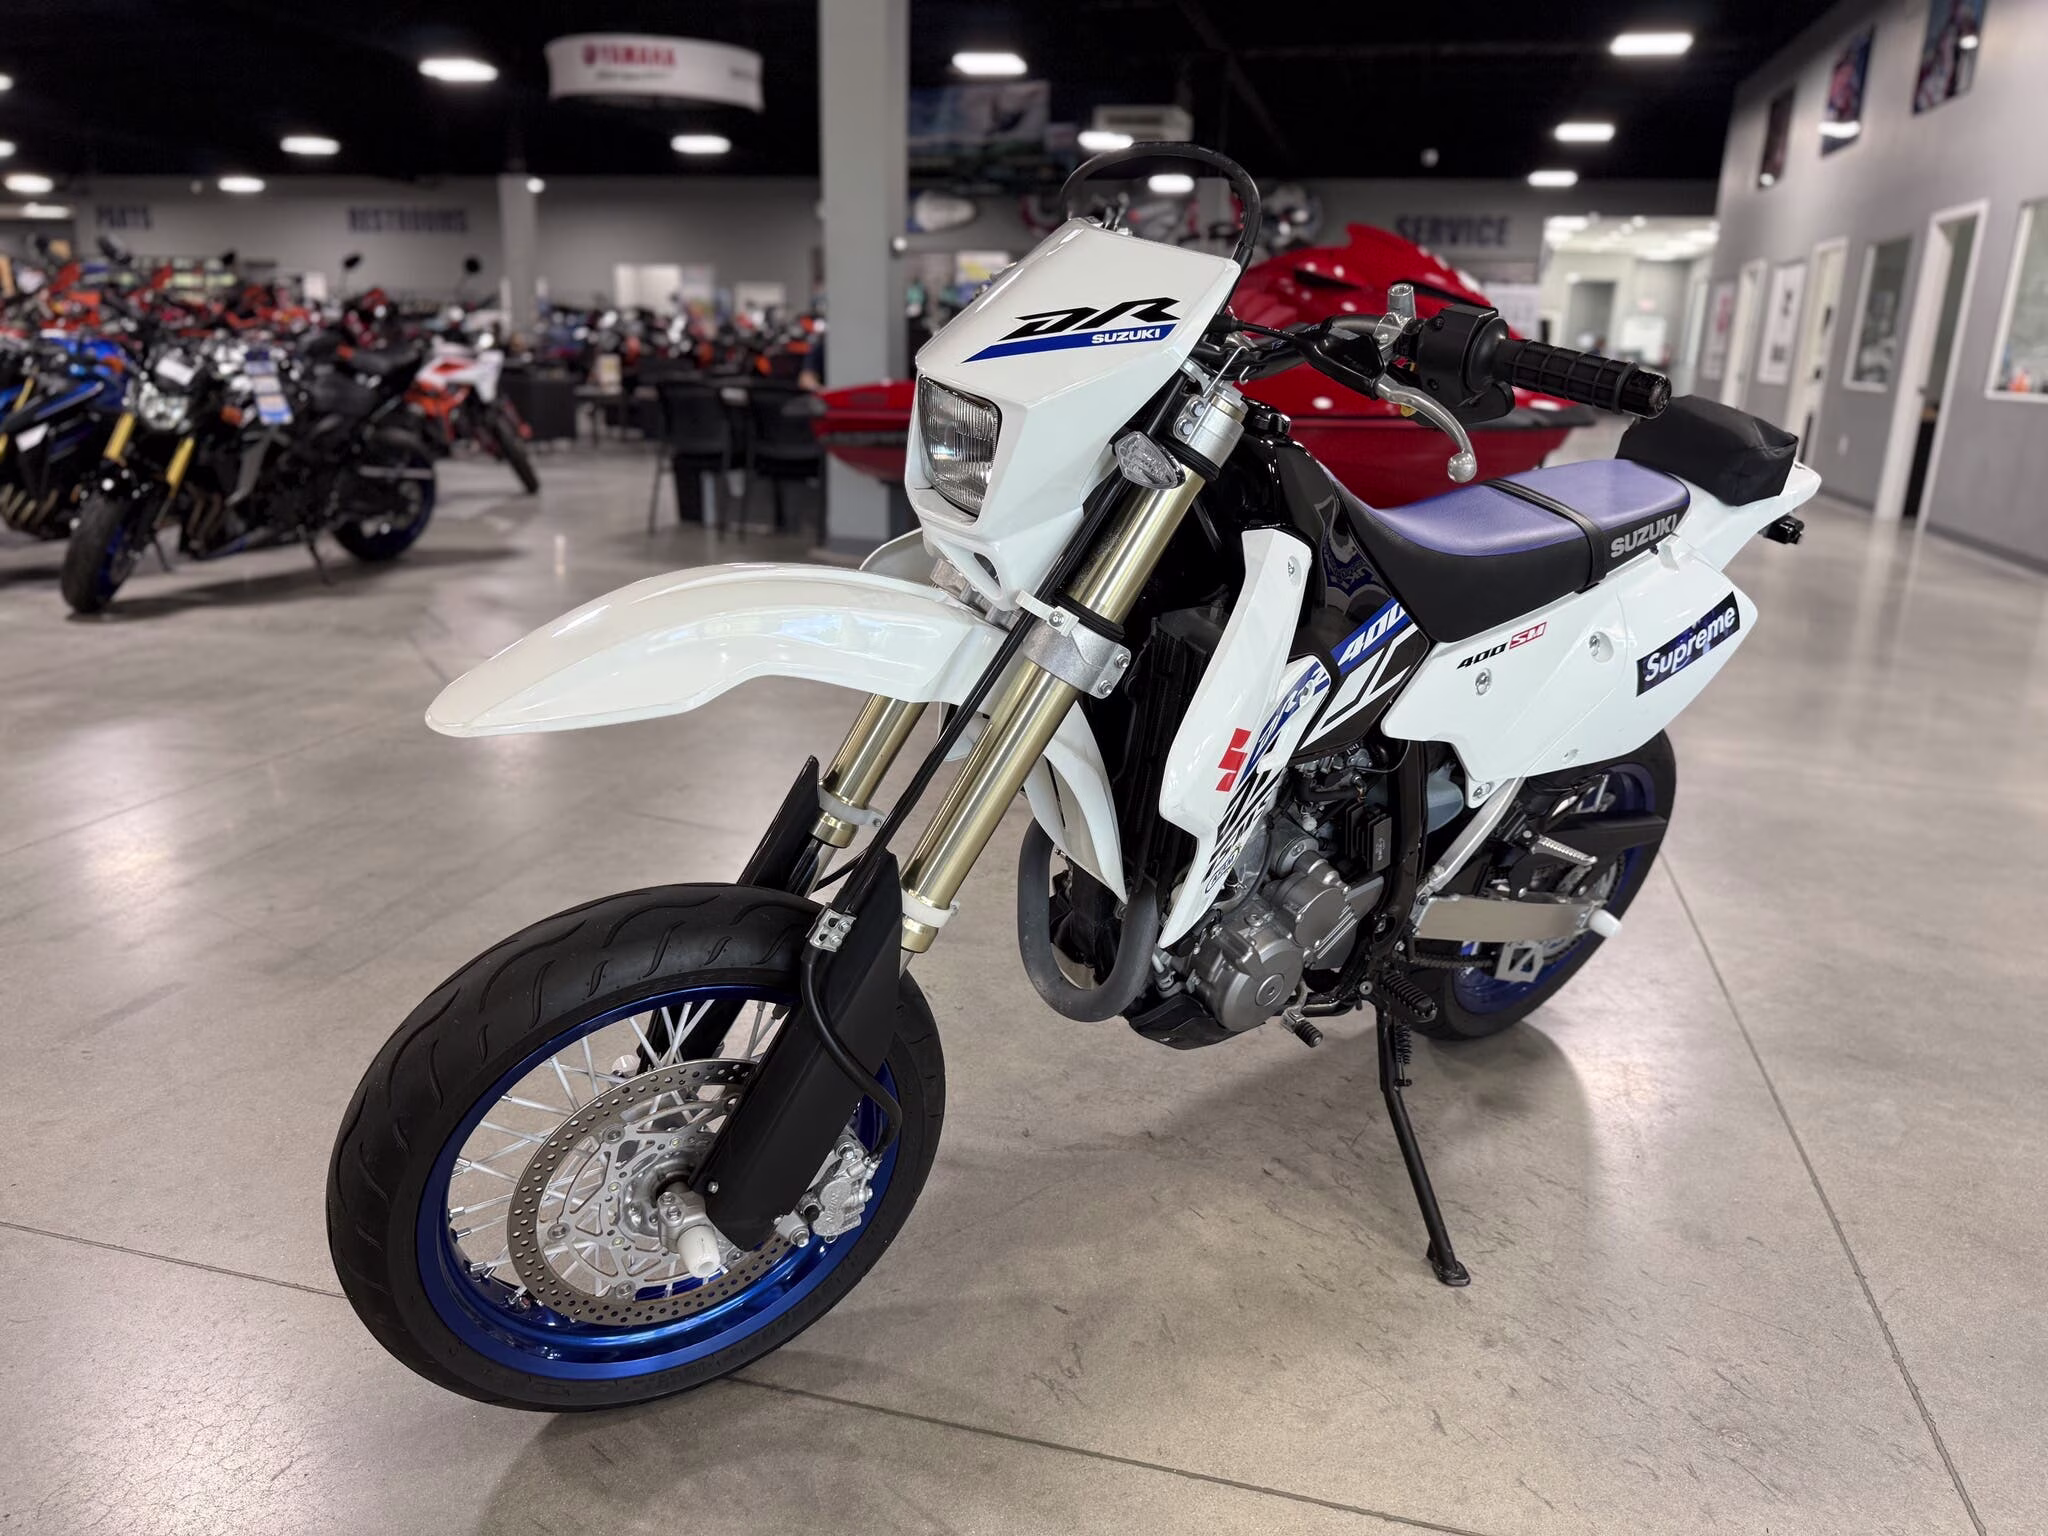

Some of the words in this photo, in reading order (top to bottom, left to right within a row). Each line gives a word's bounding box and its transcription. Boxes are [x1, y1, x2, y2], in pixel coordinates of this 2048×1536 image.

[1396, 214, 1506, 248] SERVICE
[1092, 328, 1161, 344] SUZUKI
[1610, 513, 1678, 558] SUZUKI
[1644, 606, 1736, 682] Supreme
